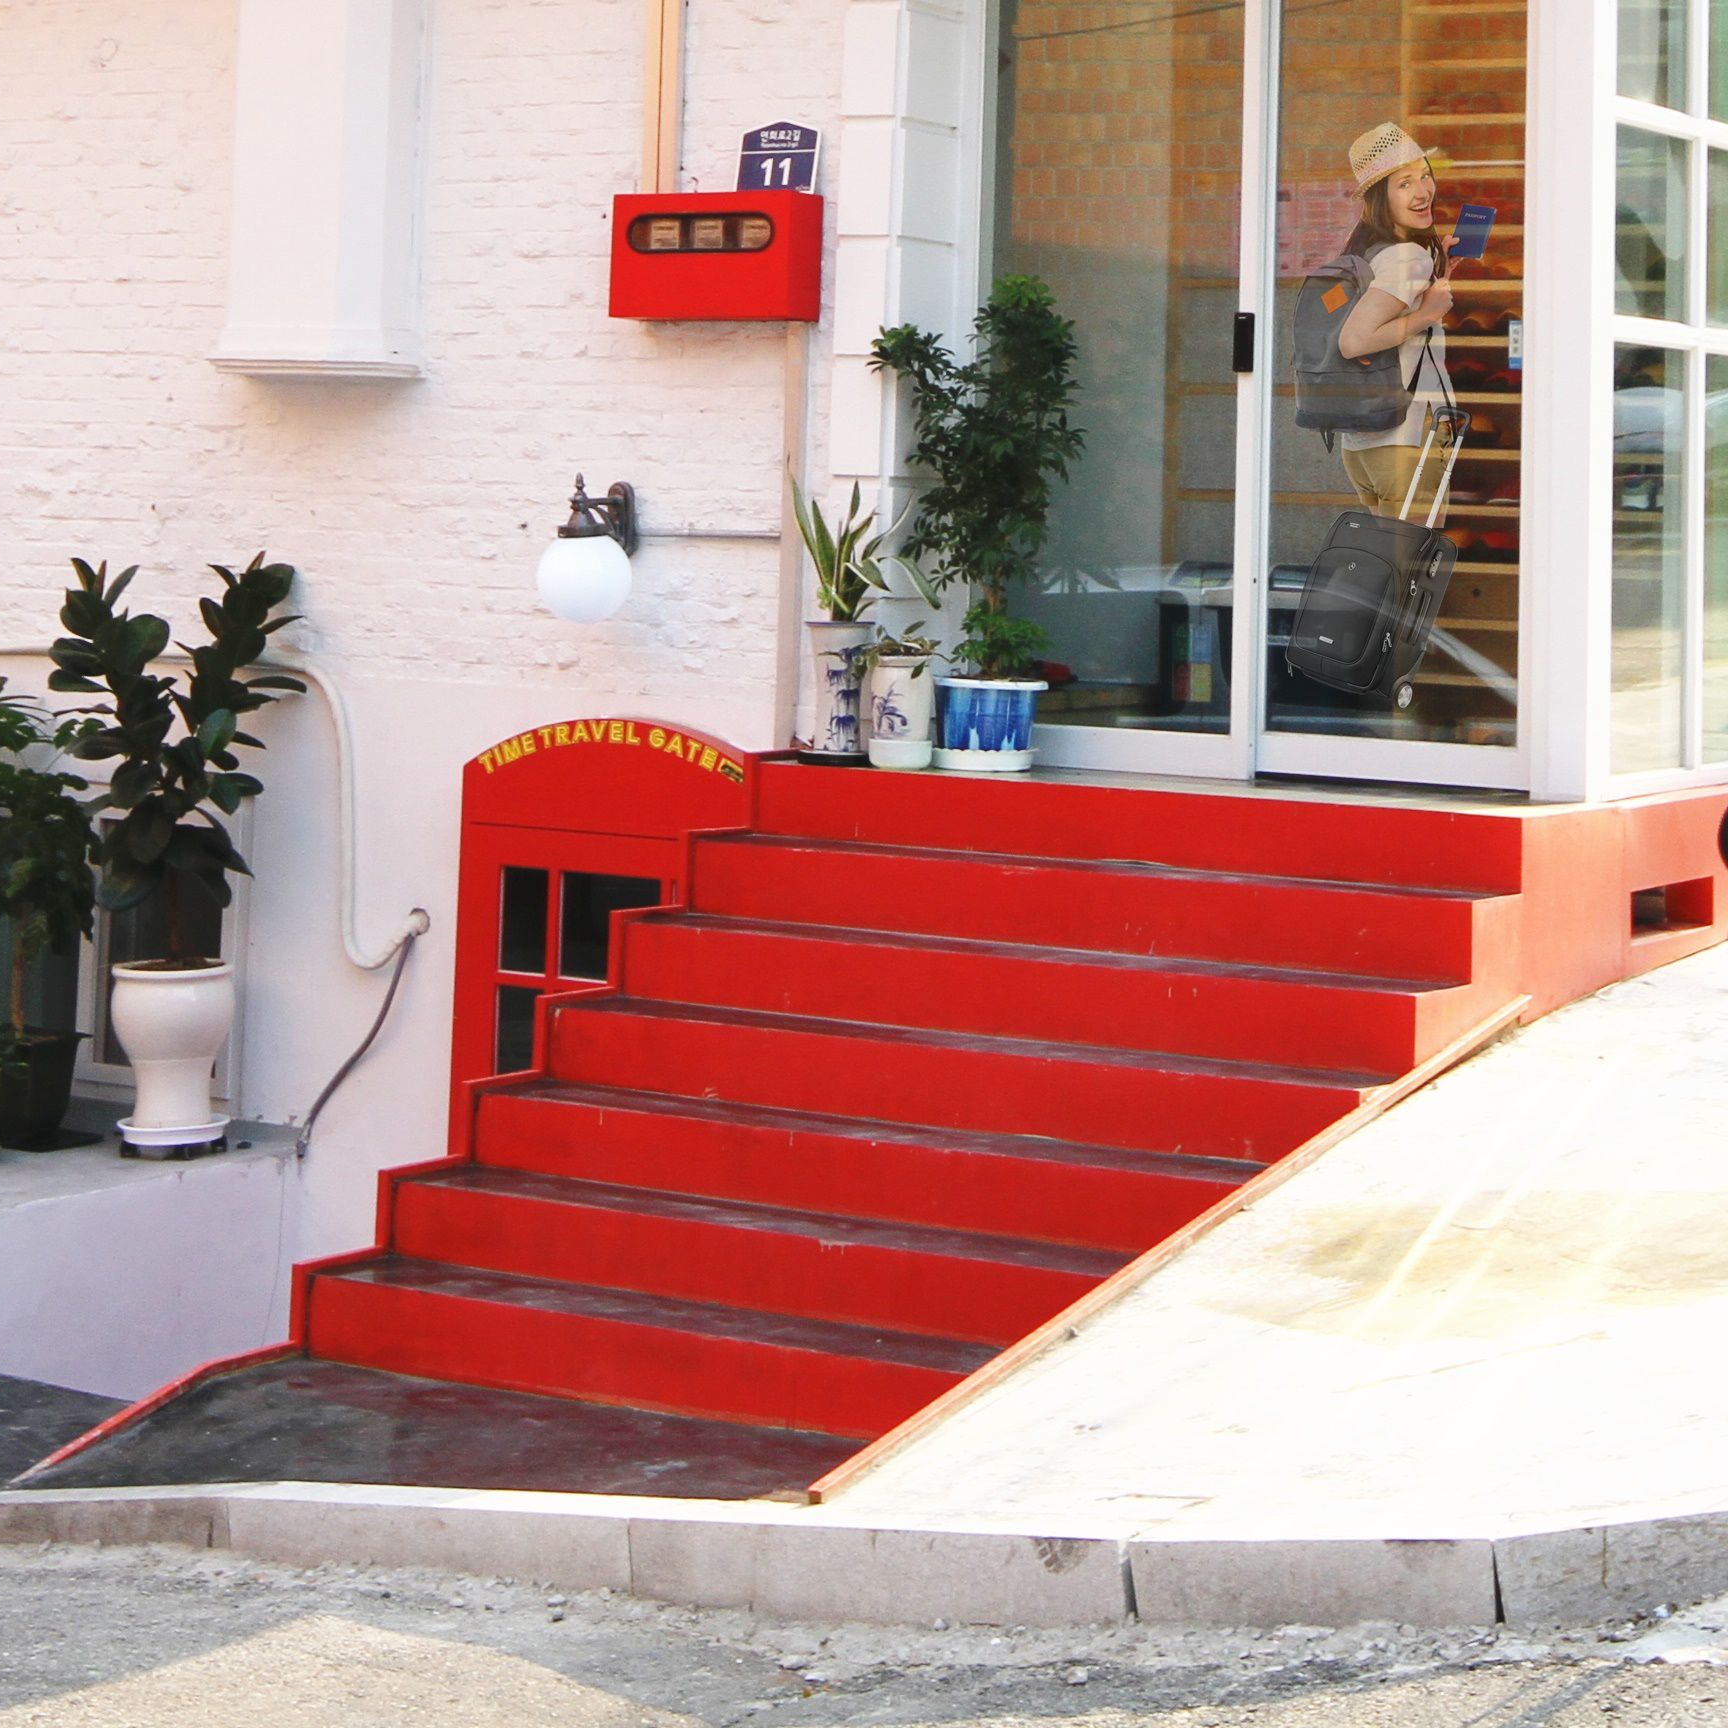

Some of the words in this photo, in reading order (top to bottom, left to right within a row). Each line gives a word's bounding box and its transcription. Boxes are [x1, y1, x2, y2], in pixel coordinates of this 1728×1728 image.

[760, 157, 792, 186] 11
[478, 734, 536, 774] TIME
[538, 720, 641, 747] TRAVEL
[647, 728, 720, 772] GATE
